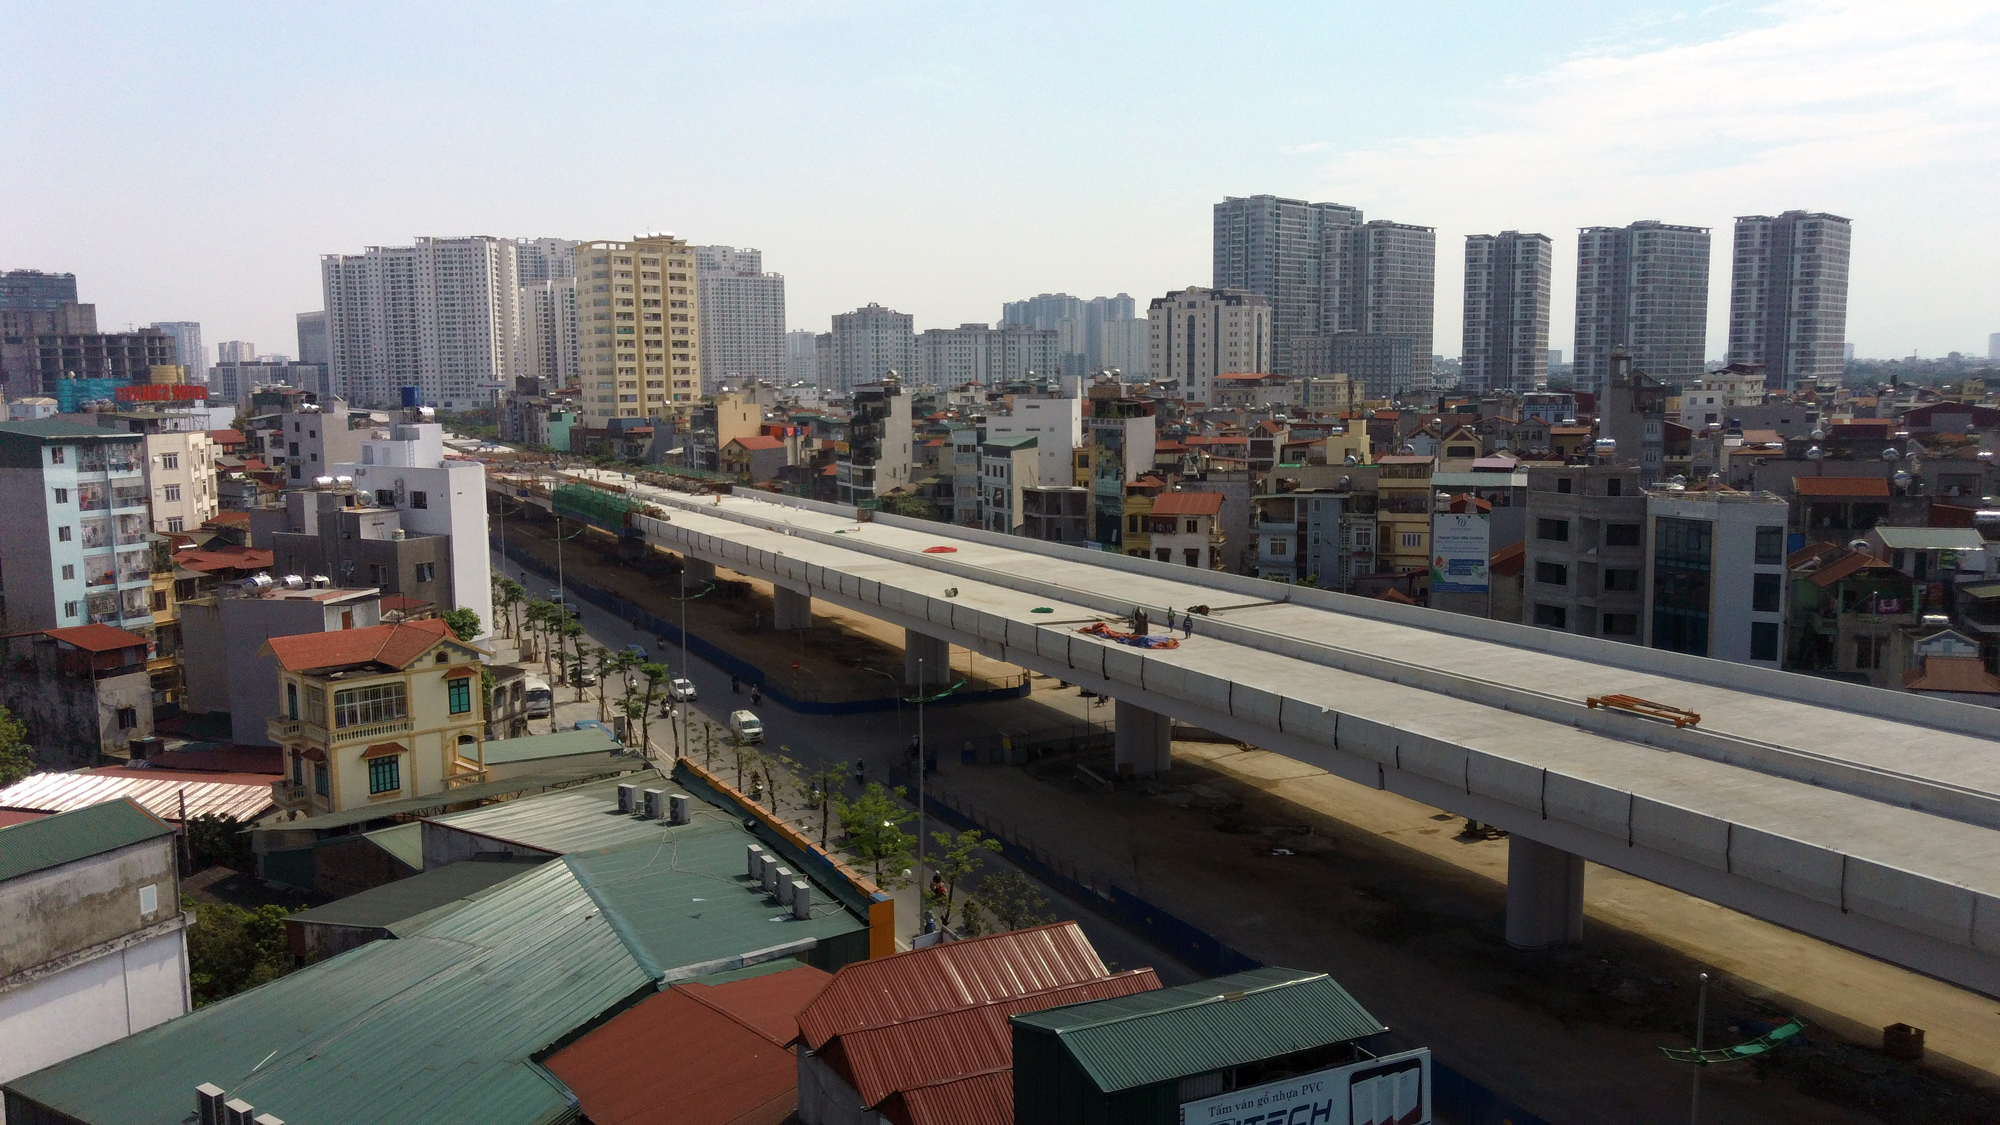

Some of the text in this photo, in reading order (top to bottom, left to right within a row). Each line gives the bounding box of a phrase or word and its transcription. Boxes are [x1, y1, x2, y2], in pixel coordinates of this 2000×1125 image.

[173, 384, 208, 400] HOTEL
[1208, 1081, 1324, 1117] Tấm ván gỗ nhựa PVC
